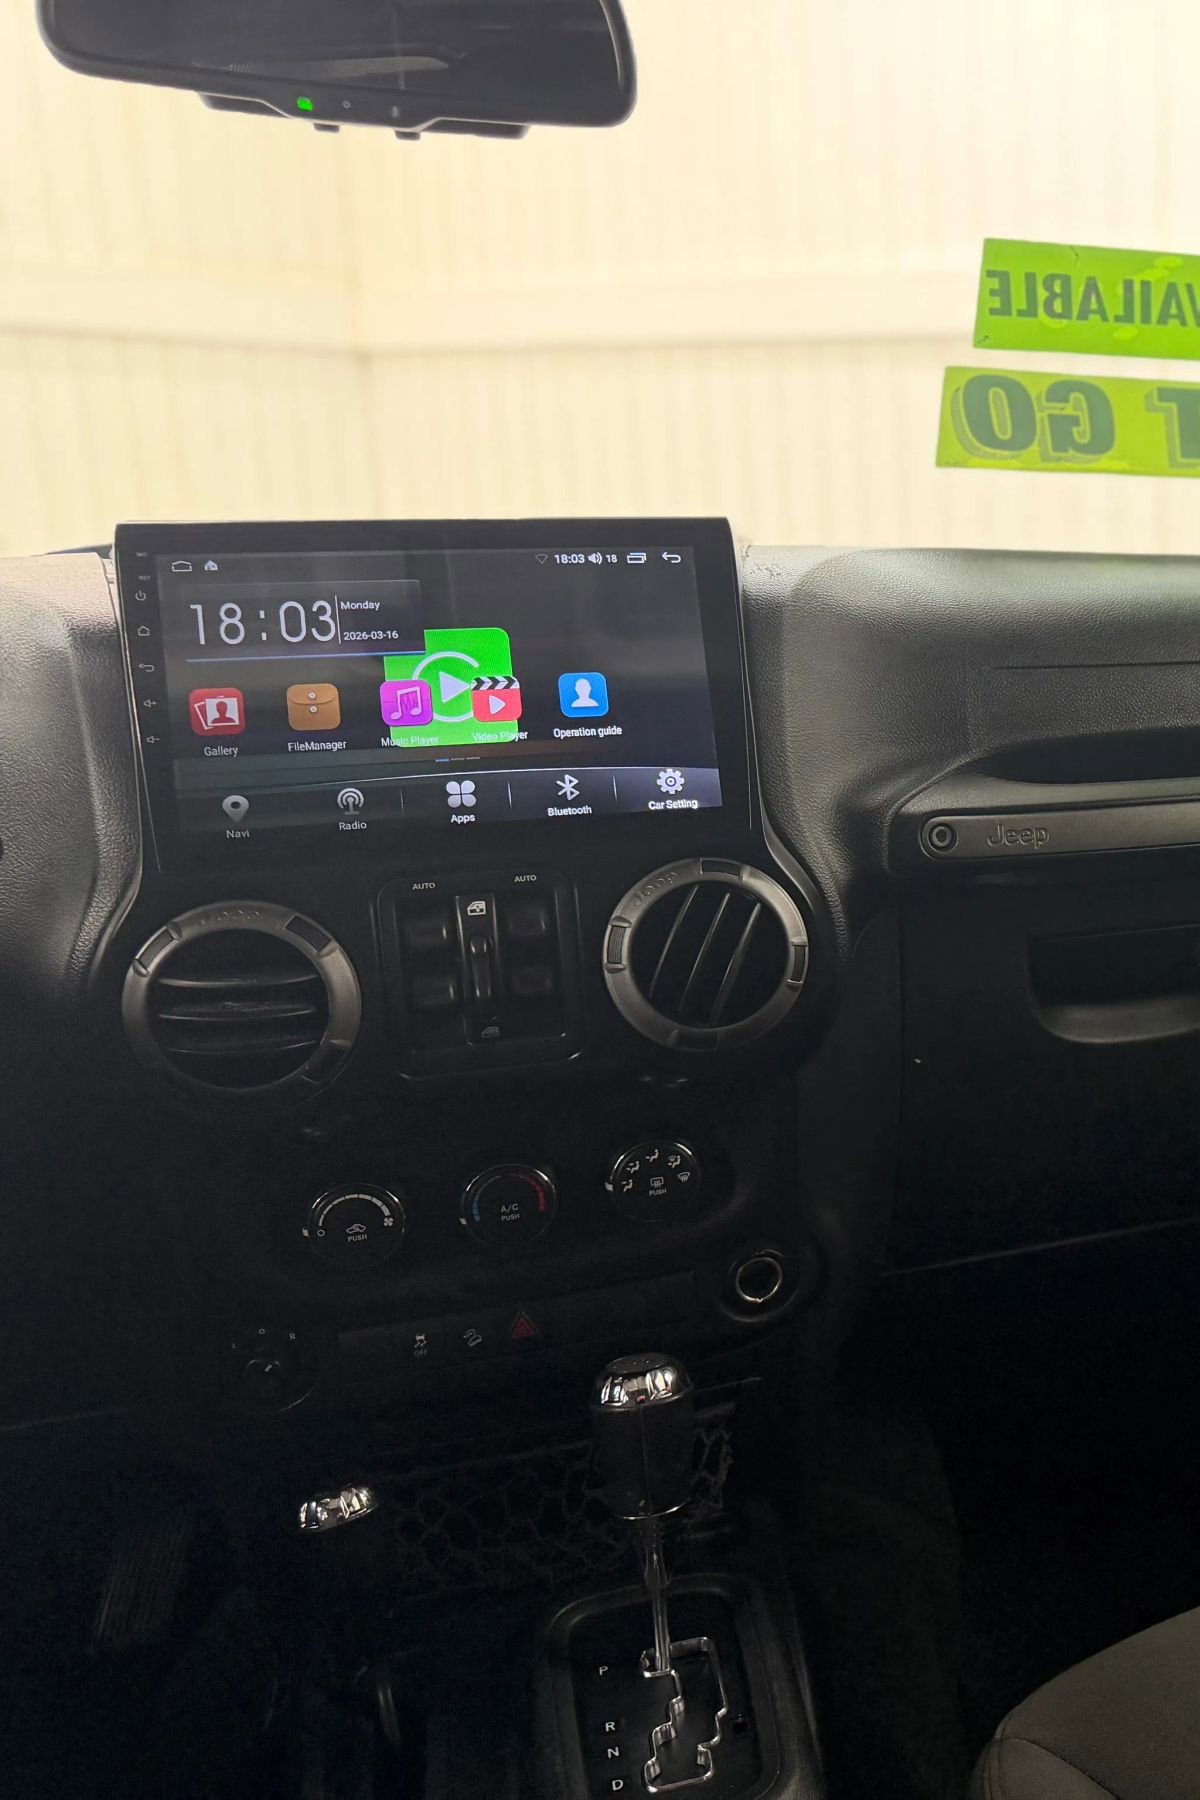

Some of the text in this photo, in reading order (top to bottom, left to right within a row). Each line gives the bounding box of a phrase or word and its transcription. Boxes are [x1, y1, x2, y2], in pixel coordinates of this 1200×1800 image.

[554, 553, 585, 564] 18:03
[605, 553, 618, 564] 18
[340, 600, 381, 612] Monday
[343, 630, 399, 641] 2026-03-16
[472, 730, 529, 742] Video Player
[553, 725, 623, 740] Operation guide
[287, 740, 347, 752] FileManager
[381, 735, 440, 747] Music Player
[203, 746, 239, 758] Gallery
[648, 798, 699, 811] Car Setting
[547, 805, 593, 817] Bluetooth
[450, 813, 476, 825] Apps
[338, 820, 368, 831] Radio
[225, 828, 250, 839] Navi
[987, 823, 1050, 850] Jeep
[513, 875, 537, 883] AUTO
[412, 882, 436, 890] AUTO
[648, 1187, 668, 1197] PUSH
[500, 1201, 519, 1214] A/C
[501, 1212, 521, 1222] PUSH
[347, 1232, 369, 1243] PUSH
[598, 1665, 609, 1676] P
[604, 1721, 617, 1733] R
[607, 1745, 621, 1759] N
[611, 1779, 625, 1792] D
